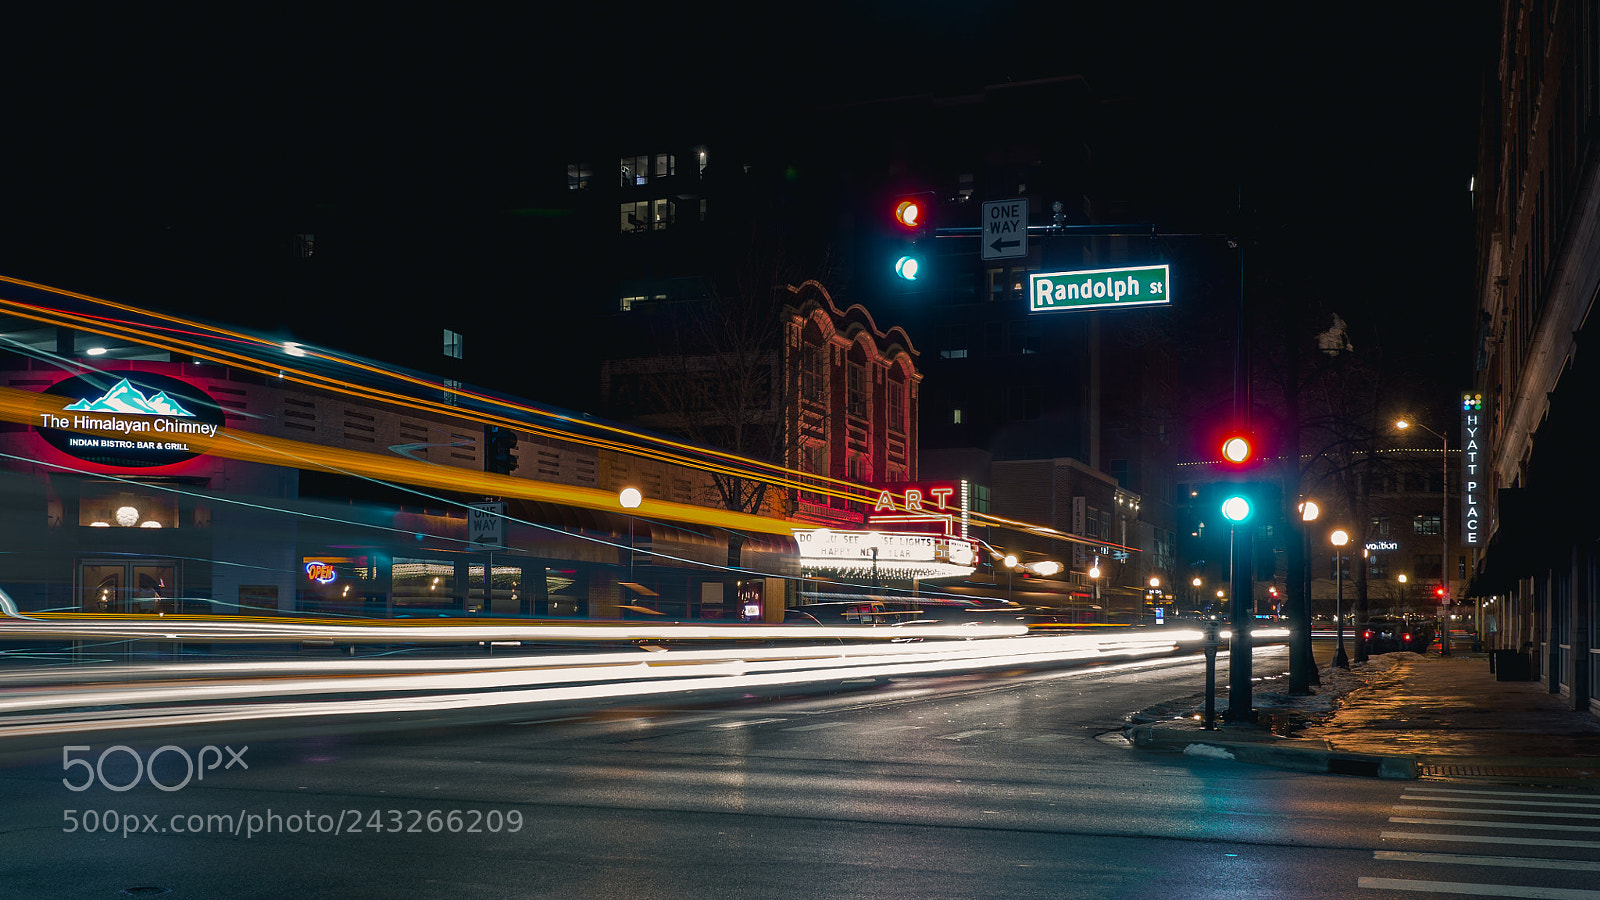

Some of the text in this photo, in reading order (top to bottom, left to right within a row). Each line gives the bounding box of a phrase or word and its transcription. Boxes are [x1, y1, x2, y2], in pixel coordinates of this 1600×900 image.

[990, 204, 1020, 219] ONE
[989, 219, 1020, 234] WAY
[1036, 275, 1163, 305] Randolph St
[40, 413, 218, 437] The Himalayan Chimney
[69, 438, 190, 451] INDIAN BISTRO: BAR & GRILL
[1467, 415, 1478, 543] HYATT PLACE
[874, 487, 954, 512] ART
[474, 505, 497, 518] ONE
[473, 519, 497, 531] WAY
[799, 533, 812, 543] DO
[843, 535, 860, 544] SEE
[899, 537, 933, 547] LIGHTS
[821, 547, 851, 556] HAPPY
[308, 564, 333, 580] OPEN
